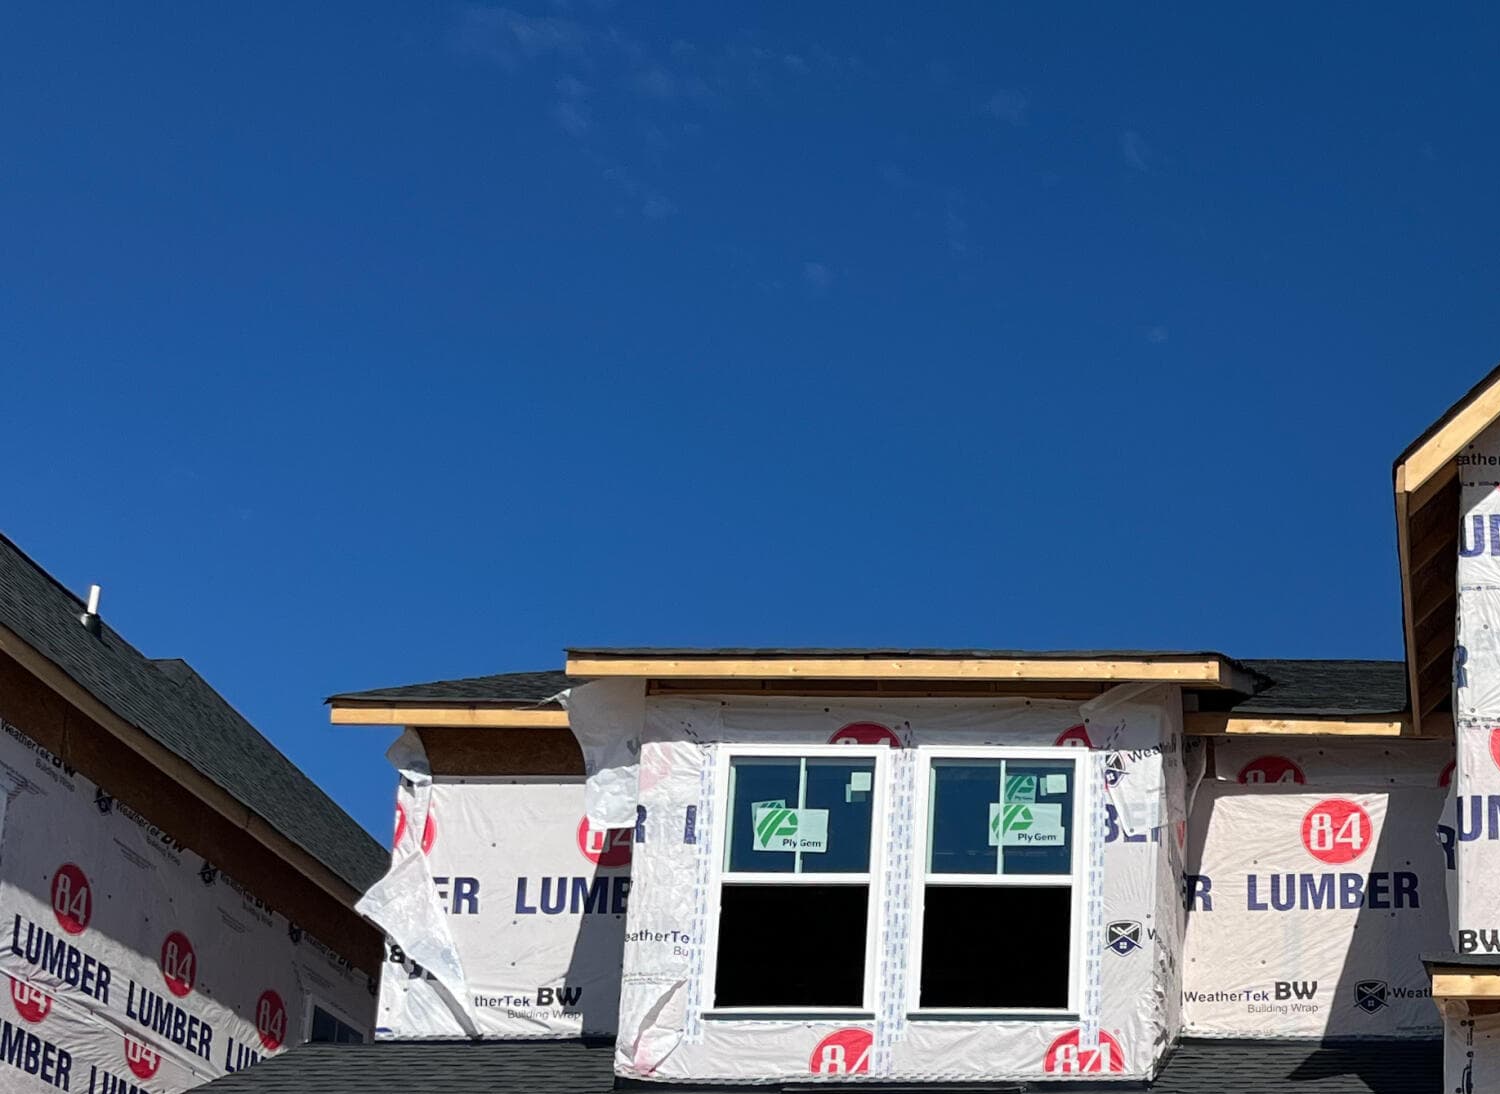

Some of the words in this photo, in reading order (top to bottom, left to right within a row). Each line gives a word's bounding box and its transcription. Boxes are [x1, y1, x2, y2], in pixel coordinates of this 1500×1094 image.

[782, 838, 798, 848] Ply
[799, 839, 821, 847] Gem
[1017, 833, 1033, 843] Ply
[1034, 833, 1057, 841] Gem
[1310, 813, 1363, 850] 84
[55, 873, 89, 926] 84
[1247, 871, 1420, 912] LUMBER
[163, 940, 193, 989] 84
[11, 913, 112, 1005] LUMBER
[126, 979, 213, 1061] LUMBER
[536, 987, 582, 1006] BW
[1184, 990, 1269, 1002] WeatherTek
[1274, 981, 1318, 1000] BW
[258, 1000, 283, 1044] 84
[507, 1010, 550, 1021] Building
[552, 1010, 582, 1020] Wrap
[1247, 1004, 1288, 1014] Building
[1291, 1004, 1318, 1013] Wrap
